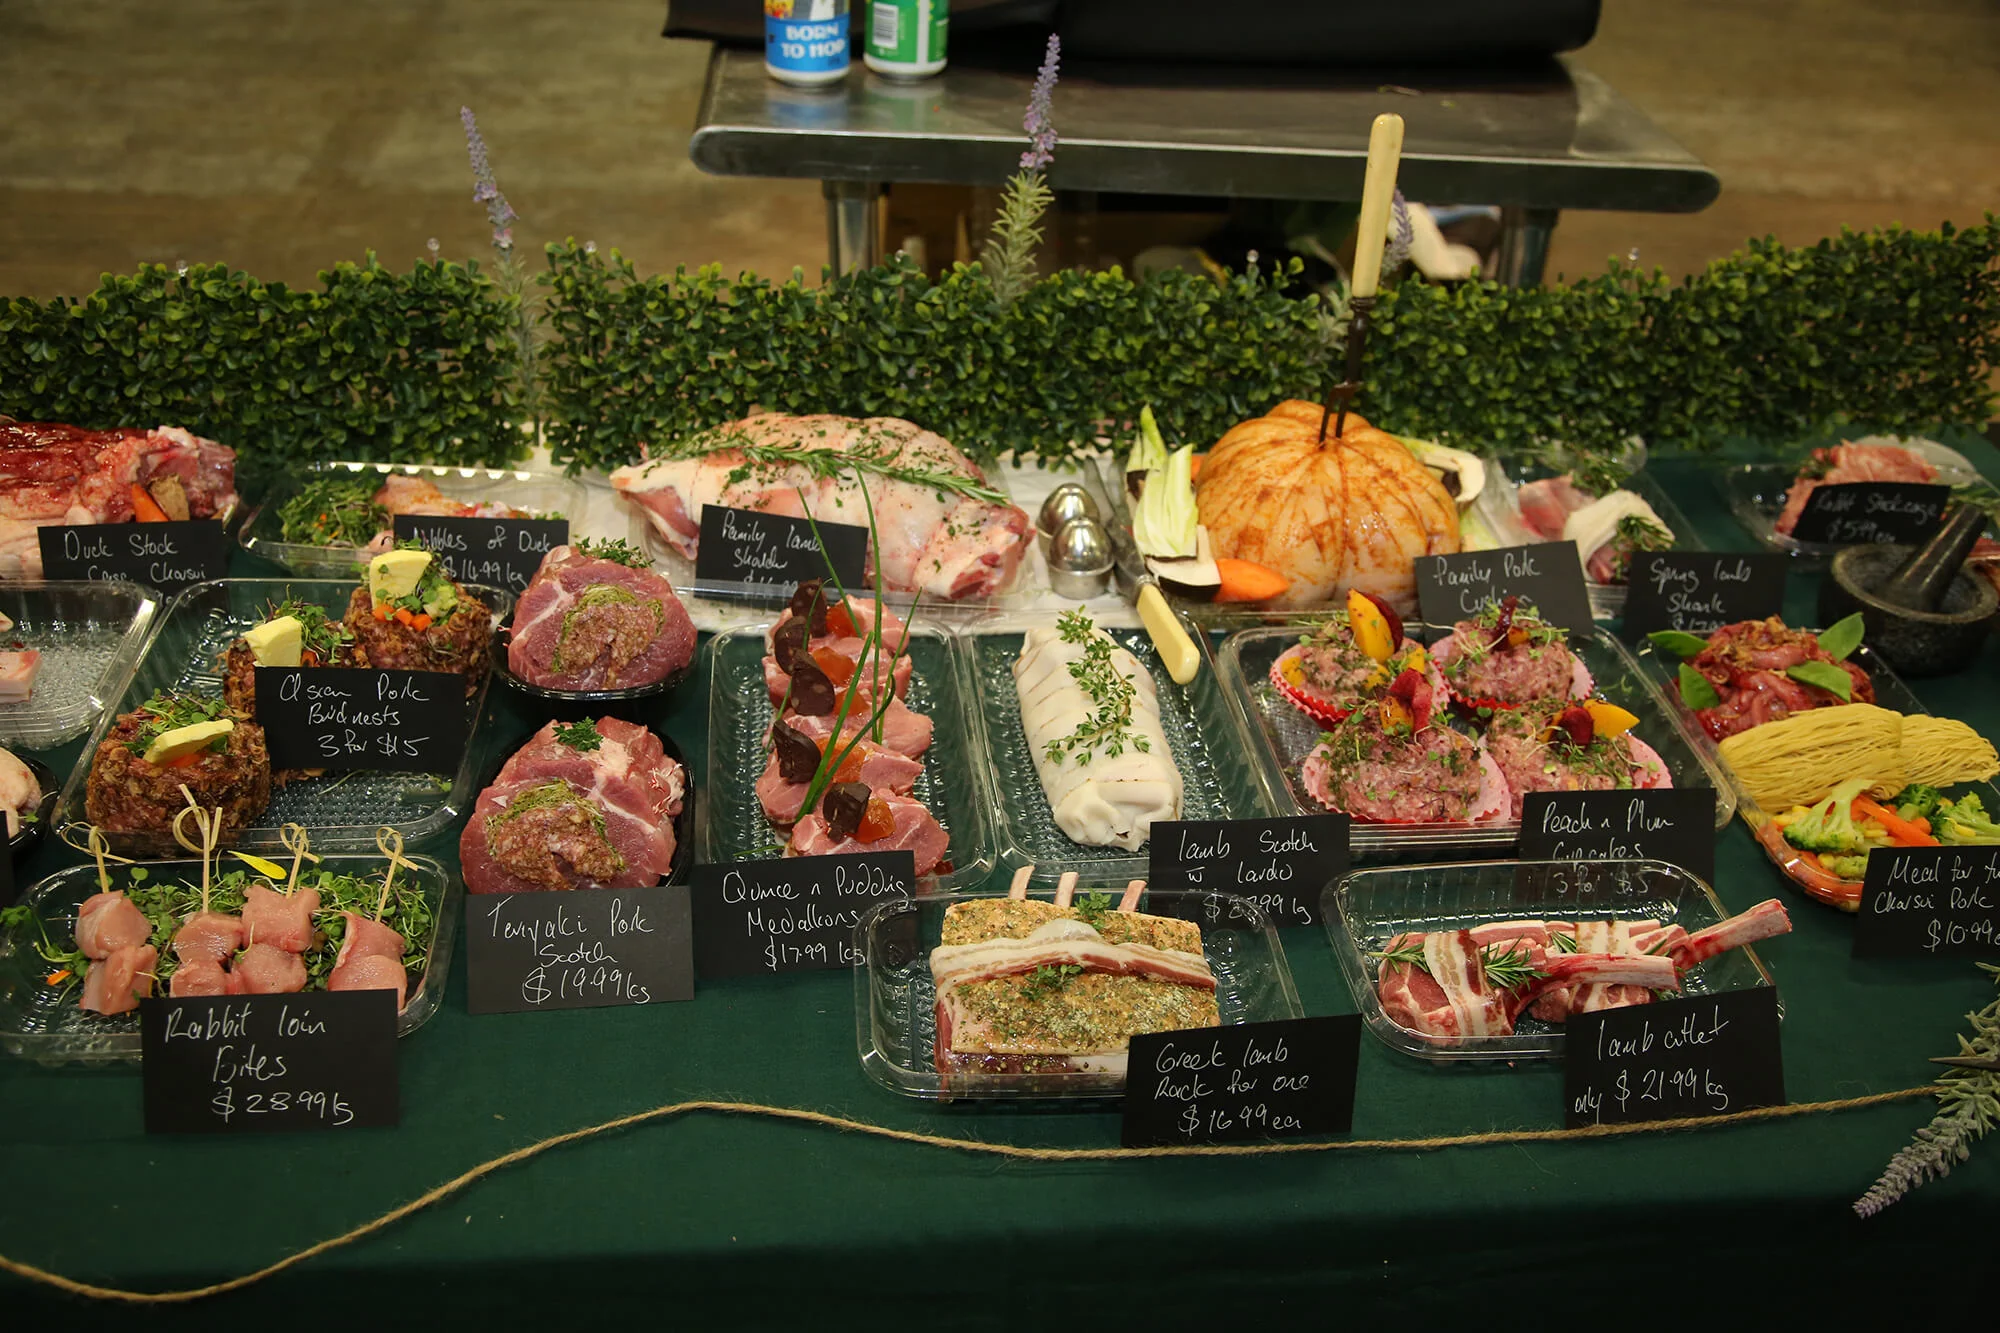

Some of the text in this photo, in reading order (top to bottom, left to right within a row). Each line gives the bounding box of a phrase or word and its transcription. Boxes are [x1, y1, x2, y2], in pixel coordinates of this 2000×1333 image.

[785, 22, 839, 42] BORN
[781, 37, 846, 59] TO HOP
[64, 530, 179, 561] Duck Stock
[518, 530, 551, 553] Duck
[1503, 550, 1542, 578] Pork
[376, 672, 430, 701] Pork
[317, 734, 340, 757] 3
[344, 728, 368, 754] for
[1542, 801, 1592, 834] Peach
[1627, 798, 1674, 833] Plum
[1259, 828, 1319, 853] Scotch
[1887, 855, 1942, 886] Meal
[1950, 855, 1973, 882] for
[1950, 886, 1994, 909] Pork
[611, 897, 654, 937] Pork
[539, 941, 619, 968] Scotch
[164, 1002, 251, 1043] Rabbit
[1155, 1042, 1226, 1074] Greek
[1227, 1068, 1258, 1095] for
